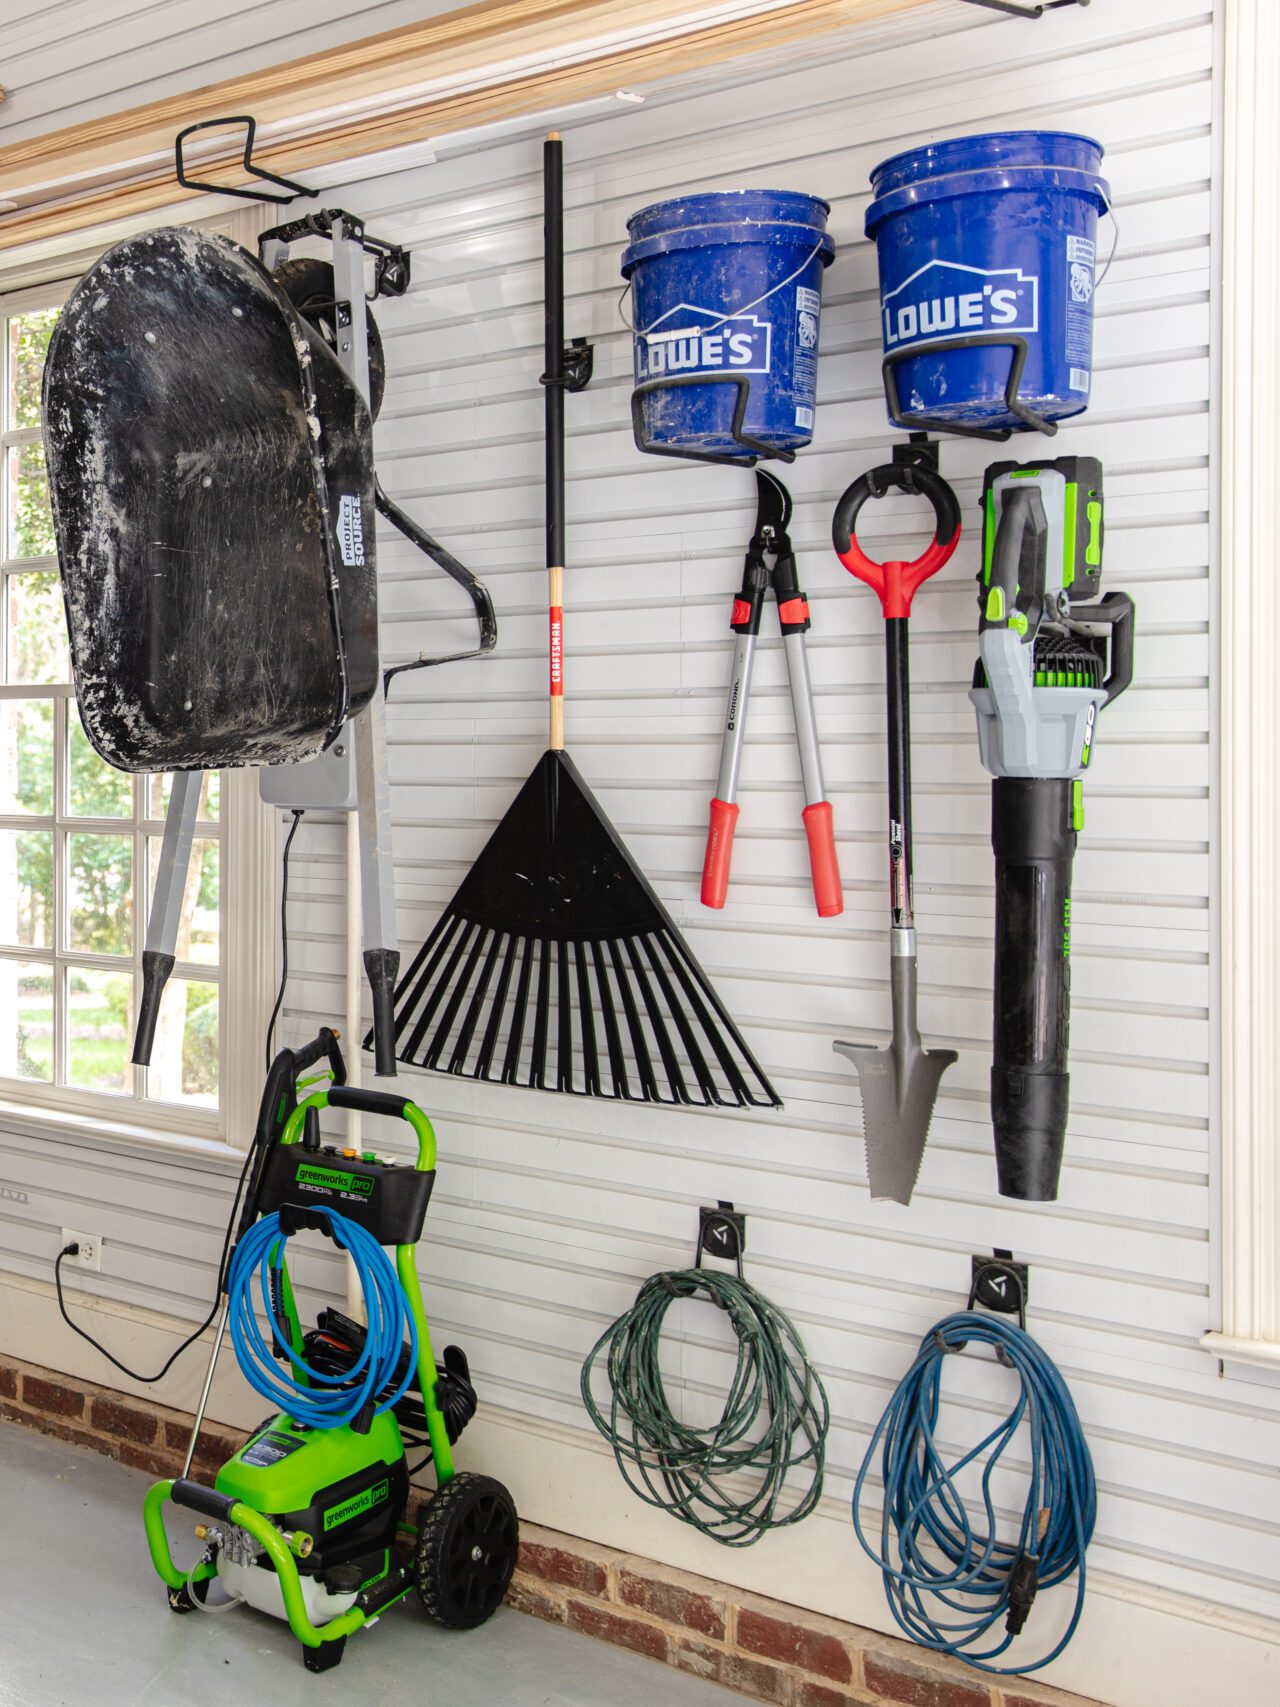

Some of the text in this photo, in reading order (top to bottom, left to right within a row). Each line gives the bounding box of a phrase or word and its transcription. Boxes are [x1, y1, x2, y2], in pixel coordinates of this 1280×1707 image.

[885, 285, 1018, 345] LOWE'S
[636, 329, 753, 377] LOWE'S
[343, 502, 353, 560] PROJECT
[352, 496, 365, 567] SOURCE
[551, 622, 561, 682] CRAFTSMAN
[729, 681, 740, 720] CORONA
[299, 1169, 371, 1191] greenworks pro
[326, 1486, 387, 1528] greenworks pro
